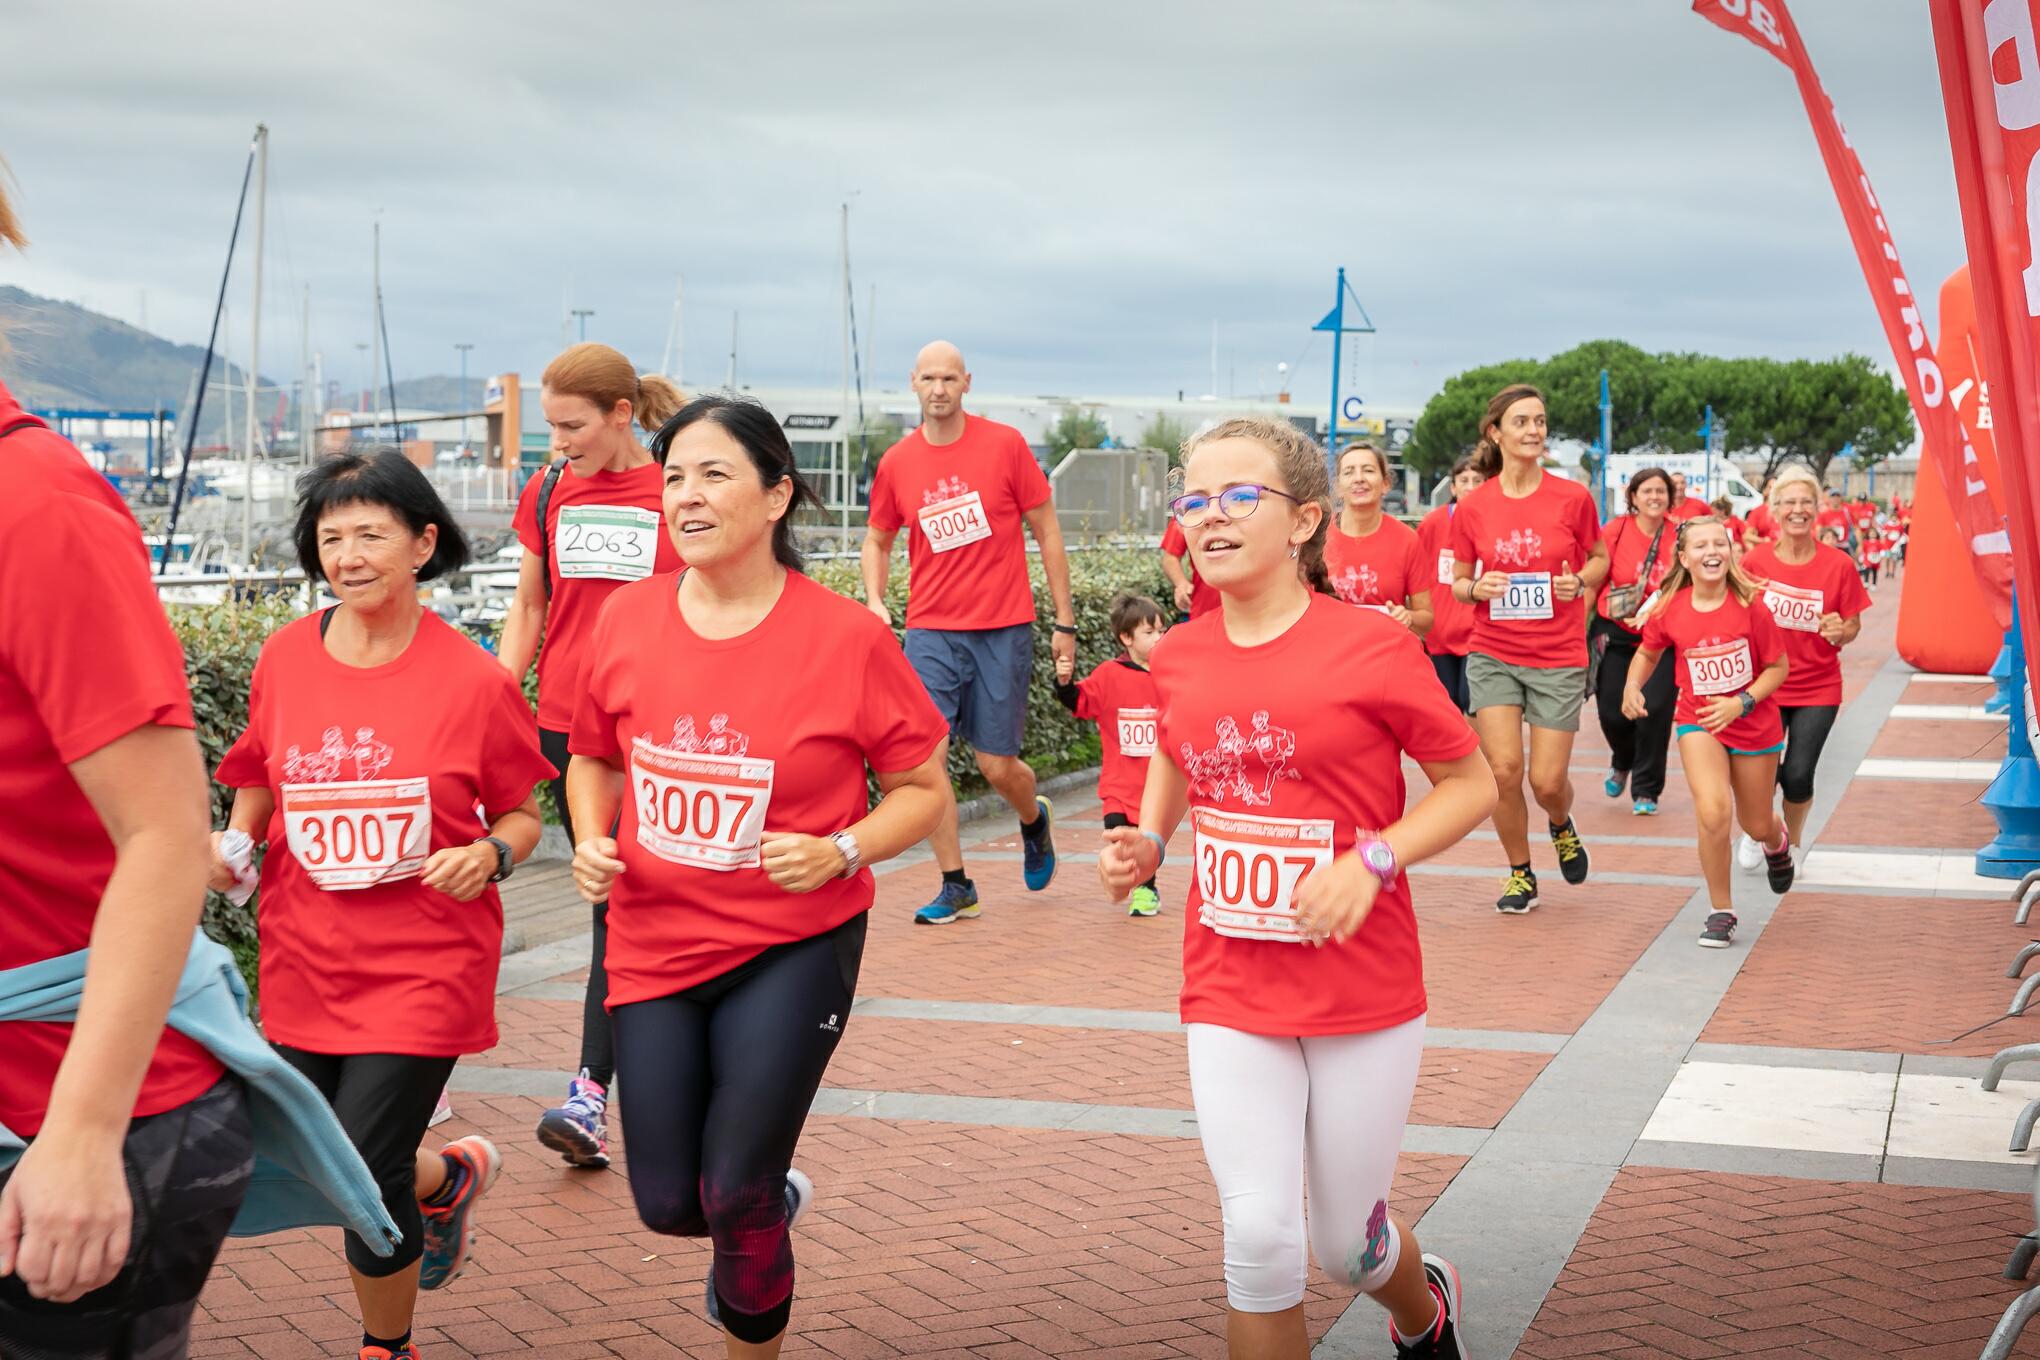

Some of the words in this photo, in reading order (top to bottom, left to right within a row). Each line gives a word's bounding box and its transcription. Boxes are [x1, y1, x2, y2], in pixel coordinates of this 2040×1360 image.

[1343, 397, 1362, 421] C
[928, 508, 979, 540] 3004
[564, 523, 643, 558] 2063
[1771, 595, 1815, 622] 3005
[1695, 652, 1746, 682] 3005
[1123, 723, 1156, 745] 300
[642, 777, 754, 843] 3007
[301, 812, 415, 865] 3007
[1203, 843, 1317, 911] 3007
